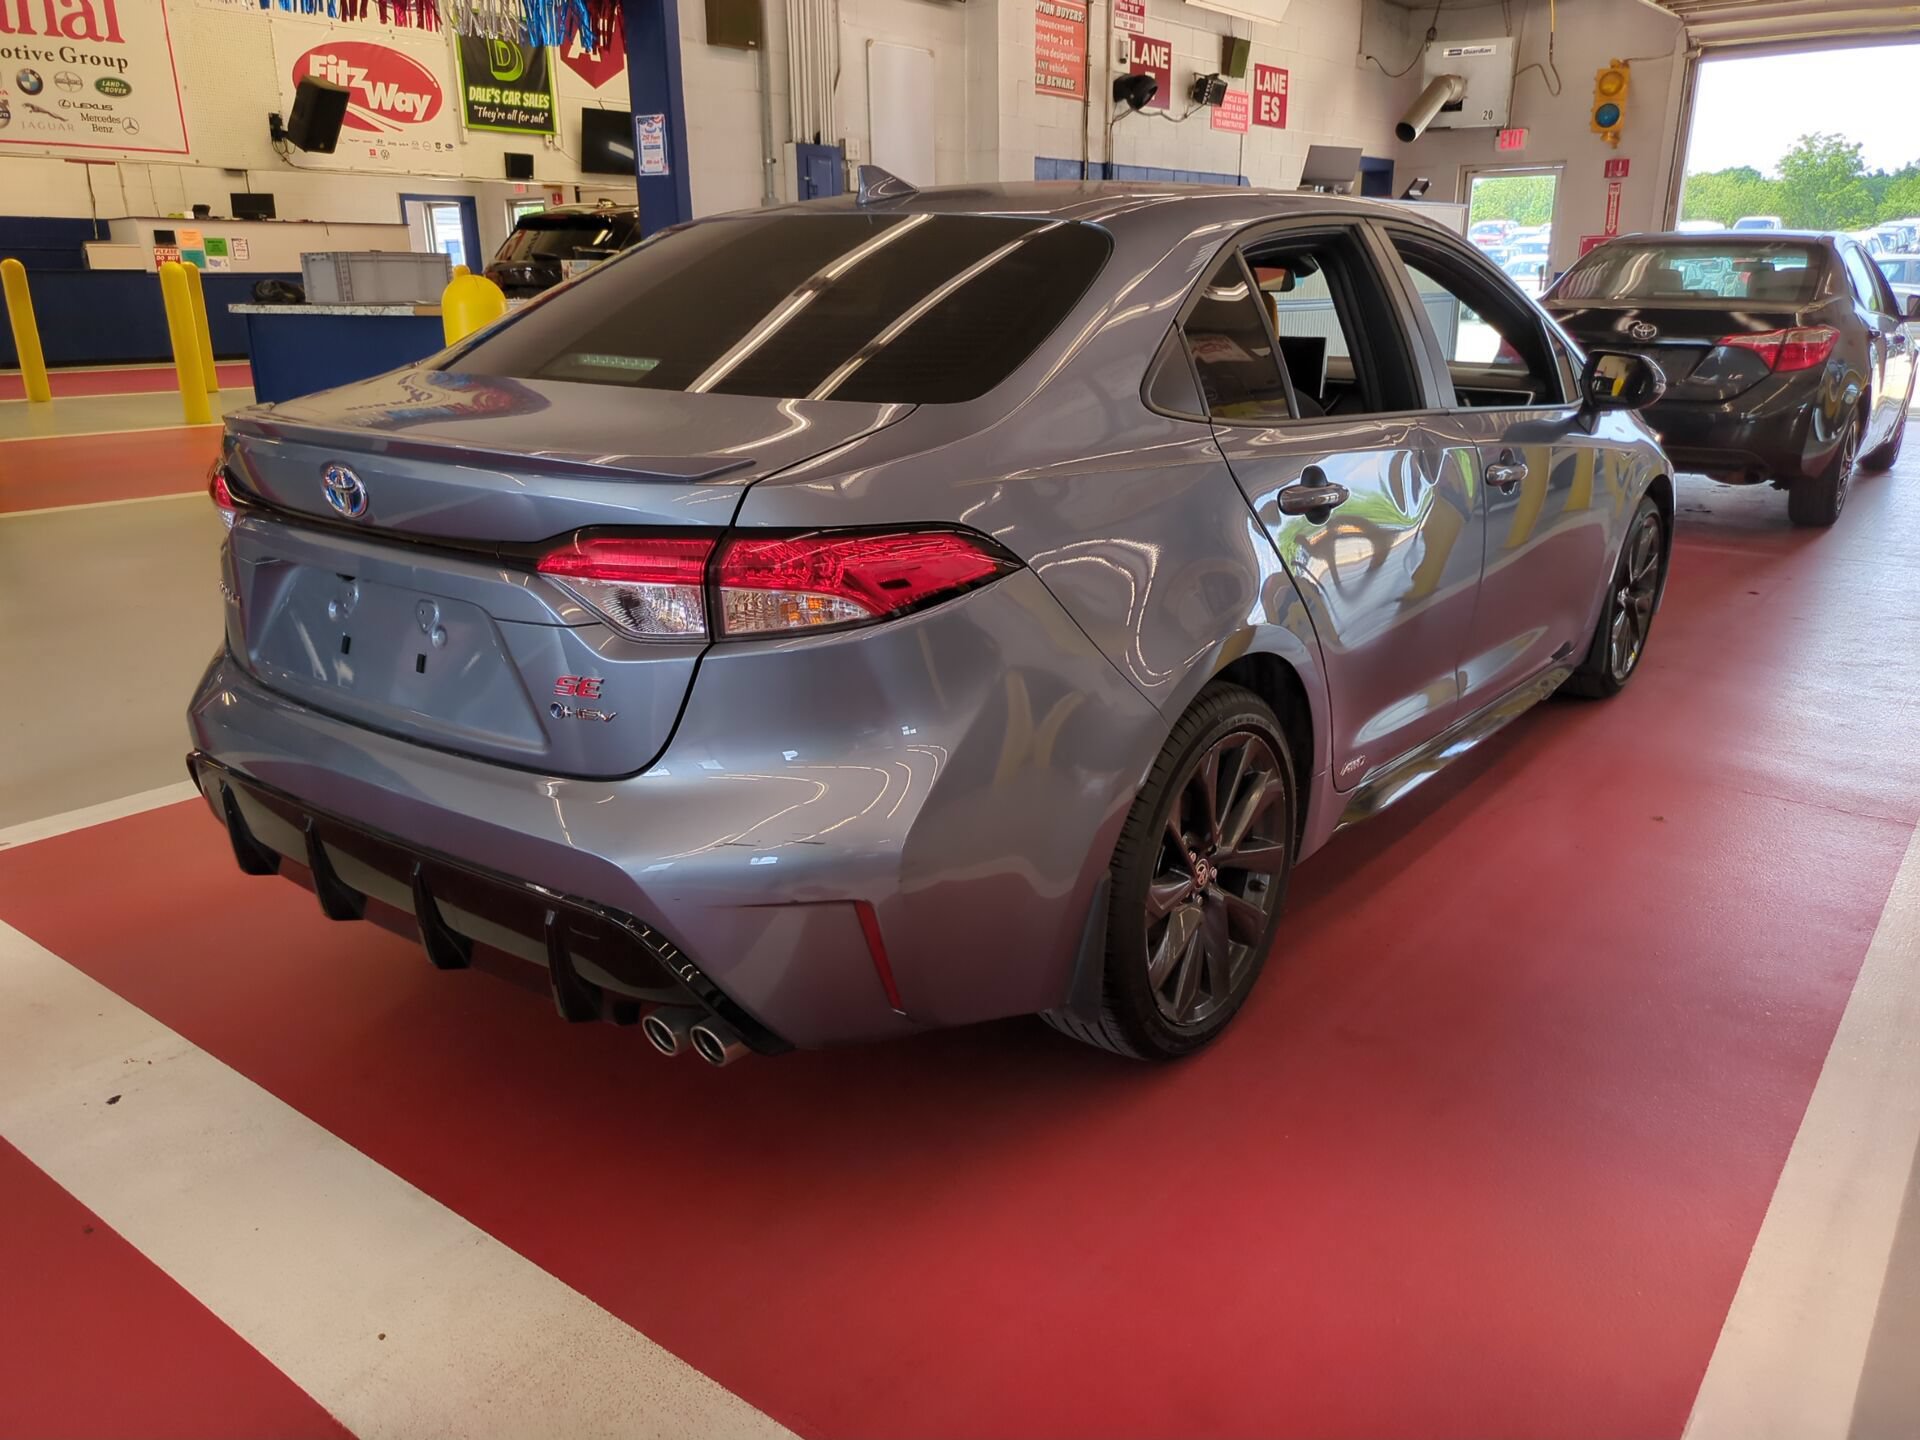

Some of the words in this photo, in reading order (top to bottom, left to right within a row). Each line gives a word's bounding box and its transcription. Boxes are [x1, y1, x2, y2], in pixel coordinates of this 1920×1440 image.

[1056, 6, 1085, 23] BUYERS:
[1050, 33, 1059, 44] for
[1050, 47, 1081, 63] designation
[1131, 40, 1169, 70] LANE
[1463, 47, 1492, 55] Guardian
[59, 46, 128, 74] Group
[1037, 60, 1049, 70] ANY
[101, 80, 120, 88] LAND
[1046, 75, 1076, 90] BEWARE
[1256, 69, 1287, 95] LANE
[103, 86, 127, 95] ROVER
[468, 86, 501, 104] DALE'S
[502, 90, 521, 106] CAR
[522, 92, 550, 109] SALES
[72, 102, 113, 111] LEXUS
[1260, 95, 1280, 123] ES
[80, 113, 121, 124] Mercedes
[507, 109, 518, 120] all
[518, 111, 530, 124] for
[1482, 110, 1494, 121] 20
[22, 121, 75, 132] JAGUAR
[92, 123, 114, 134] Benz
[1500, 128, 1524, 150] EXIT
[553, 675, 605, 700] SE
